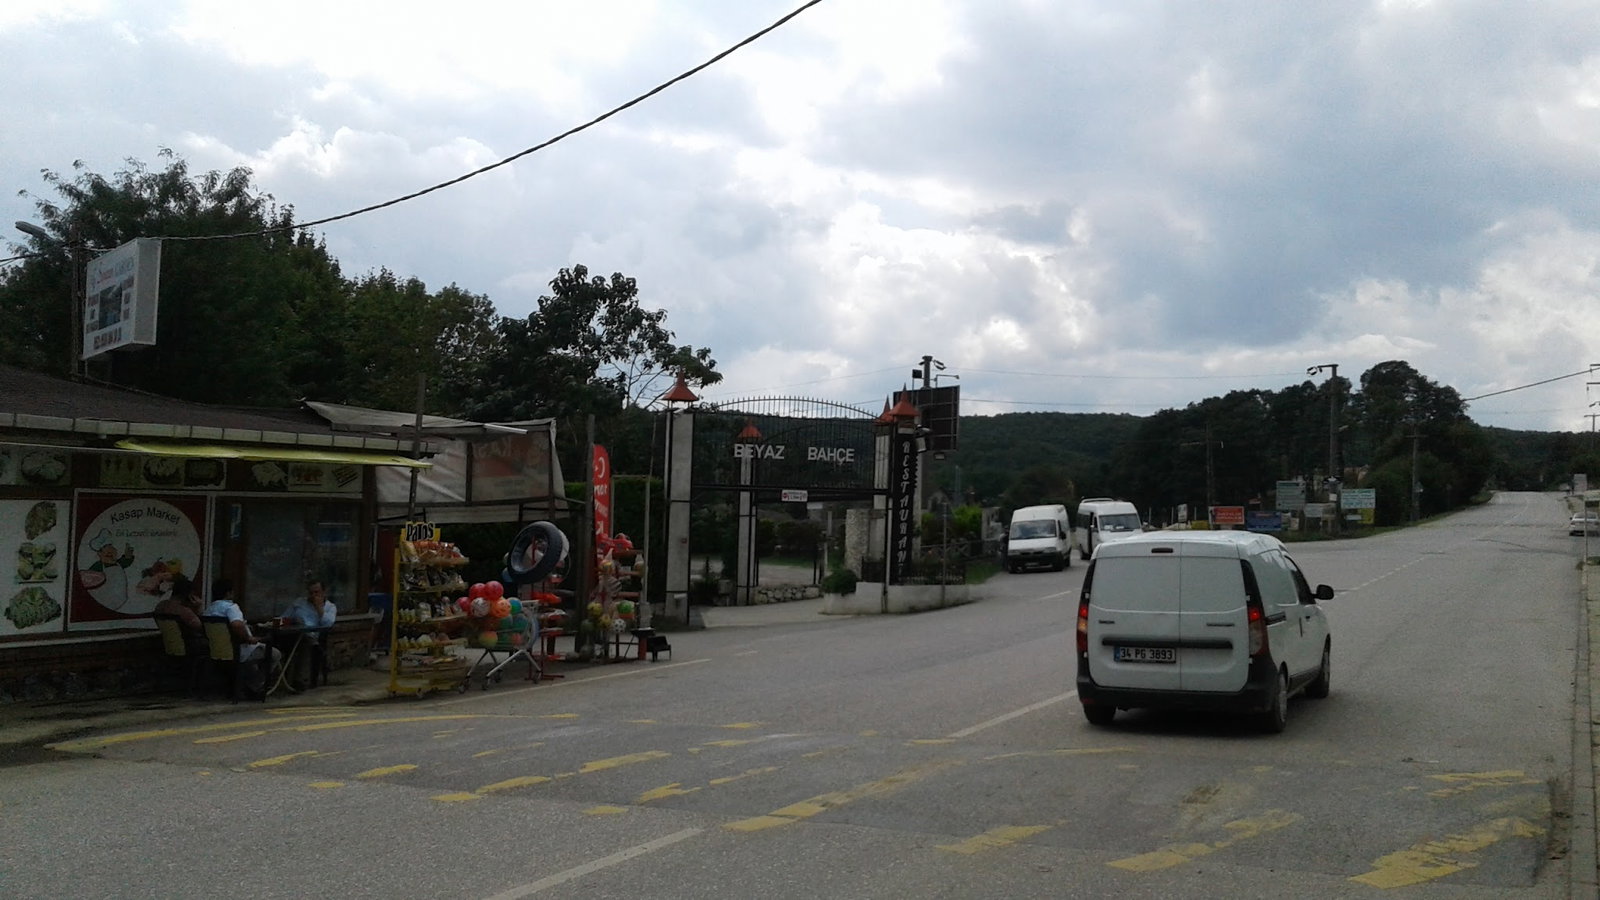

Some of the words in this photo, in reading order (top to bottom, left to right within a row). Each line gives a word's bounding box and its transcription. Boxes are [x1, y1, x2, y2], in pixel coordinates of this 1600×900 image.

[733, 443, 785, 459] BEYAZ
[807, 446, 855, 465] BAHÇE
[110, 508, 143, 525] Kasap
[147, 506, 181, 525] Market
[1120, 648, 1132, 658] 34
[1134, 648, 1146, 659] PG
[1149, 649, 1173, 660] 3893
